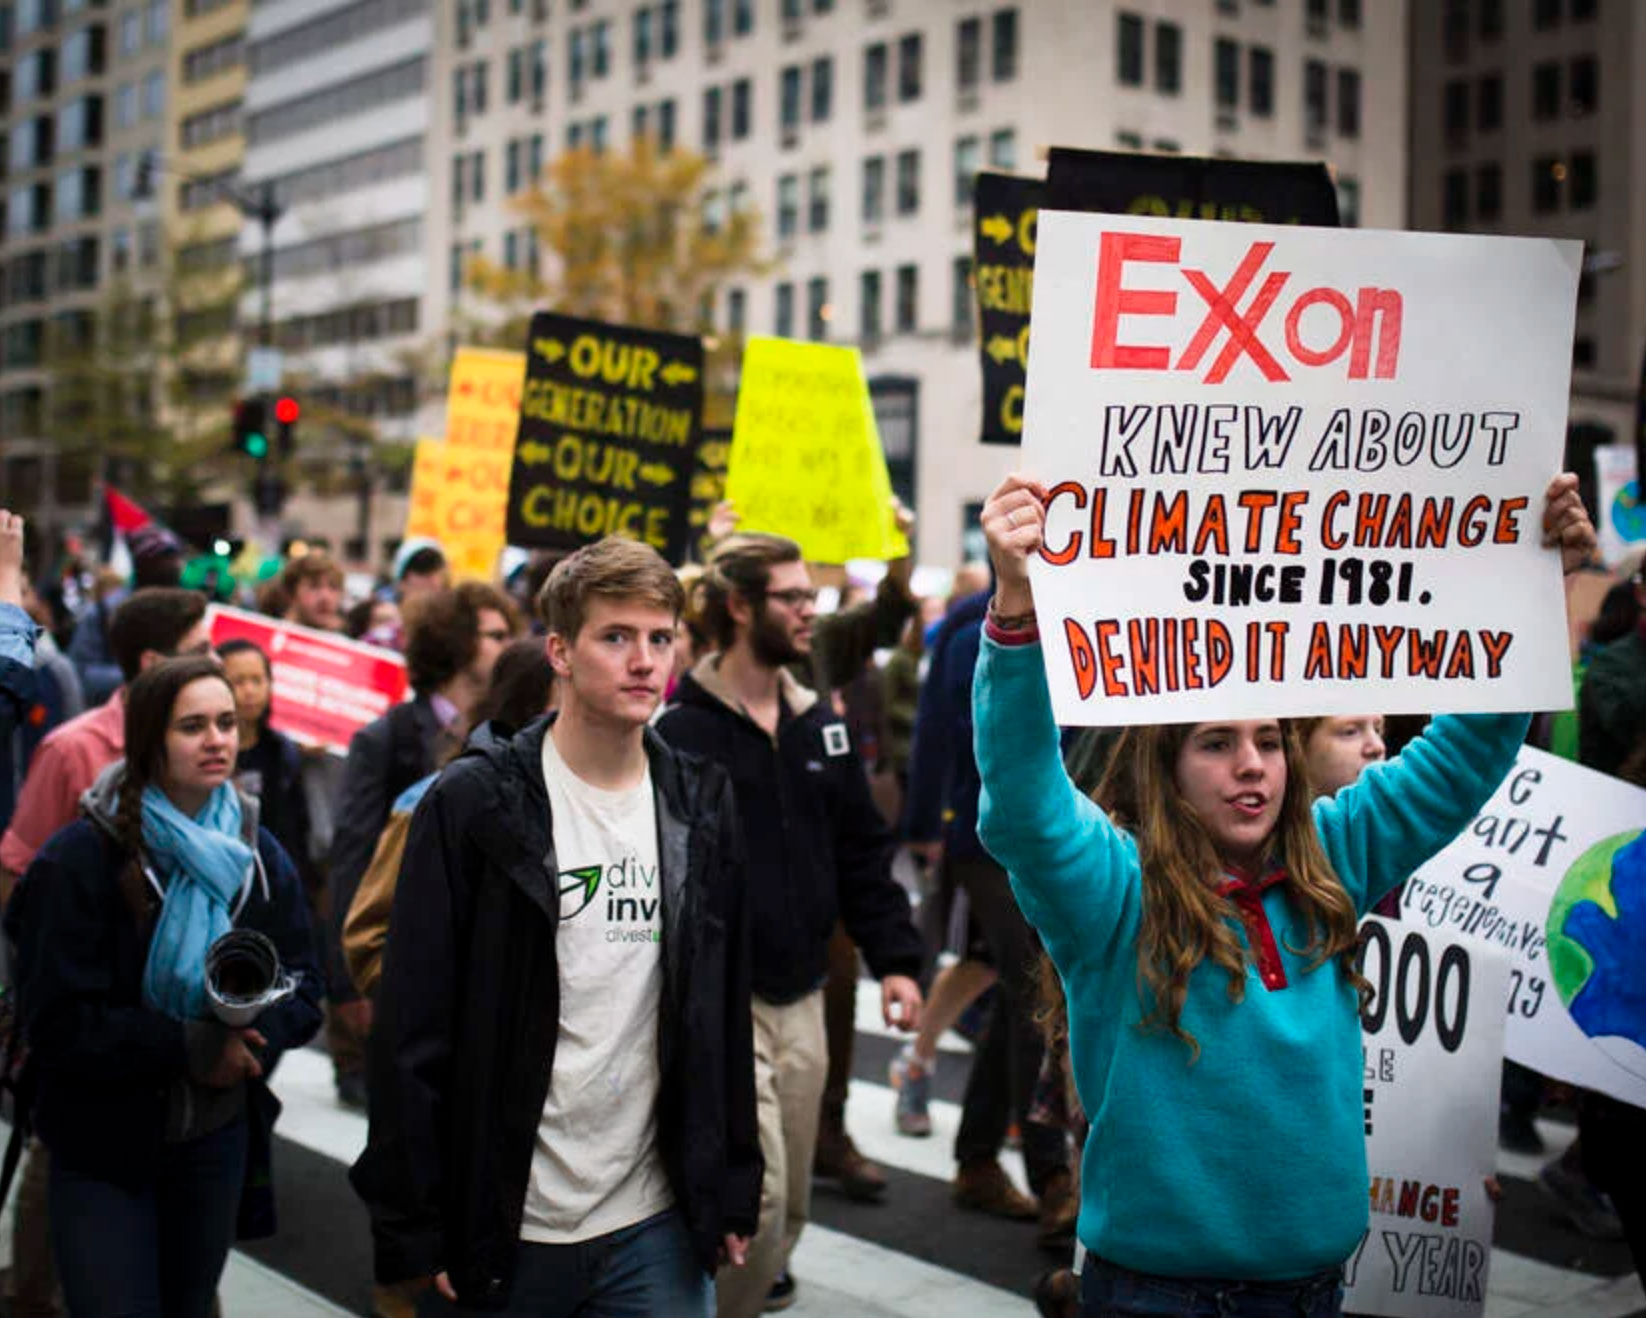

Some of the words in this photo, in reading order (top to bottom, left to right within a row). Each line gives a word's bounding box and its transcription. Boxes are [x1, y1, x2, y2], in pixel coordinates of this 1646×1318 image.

[1090, 231, 1404, 384] Exxon
[570, 335, 660, 390] OUR
[524, 379, 691, 447] GENERATION
[1100, 404, 1301, 477] KNEW
[1309, 409, 1520, 472] ABOUT
[554, 435, 639, 491] OUR
[521, 484, 670, 548] CHOICE
[1038, 481, 1308, 565] CLIMATE
[1320, 491, 1528, 549] CHANGE
[1183, 559, 1305, 606] SINCE
[1319, 558, 1432, 605] 1981.
[1064, 617, 1233, 700] DENIED
[1246, 621, 1289, 682] IT
[1305, 621, 1513, 680] ANYWAY
[1510, 769, 1542, 805] e
[1473, 815, 1567, 867] ant
[606, 891, 658, 922] inv
[1462, 862, 1502, 900] a
[1382, 1231, 1485, 1303] YEAR
